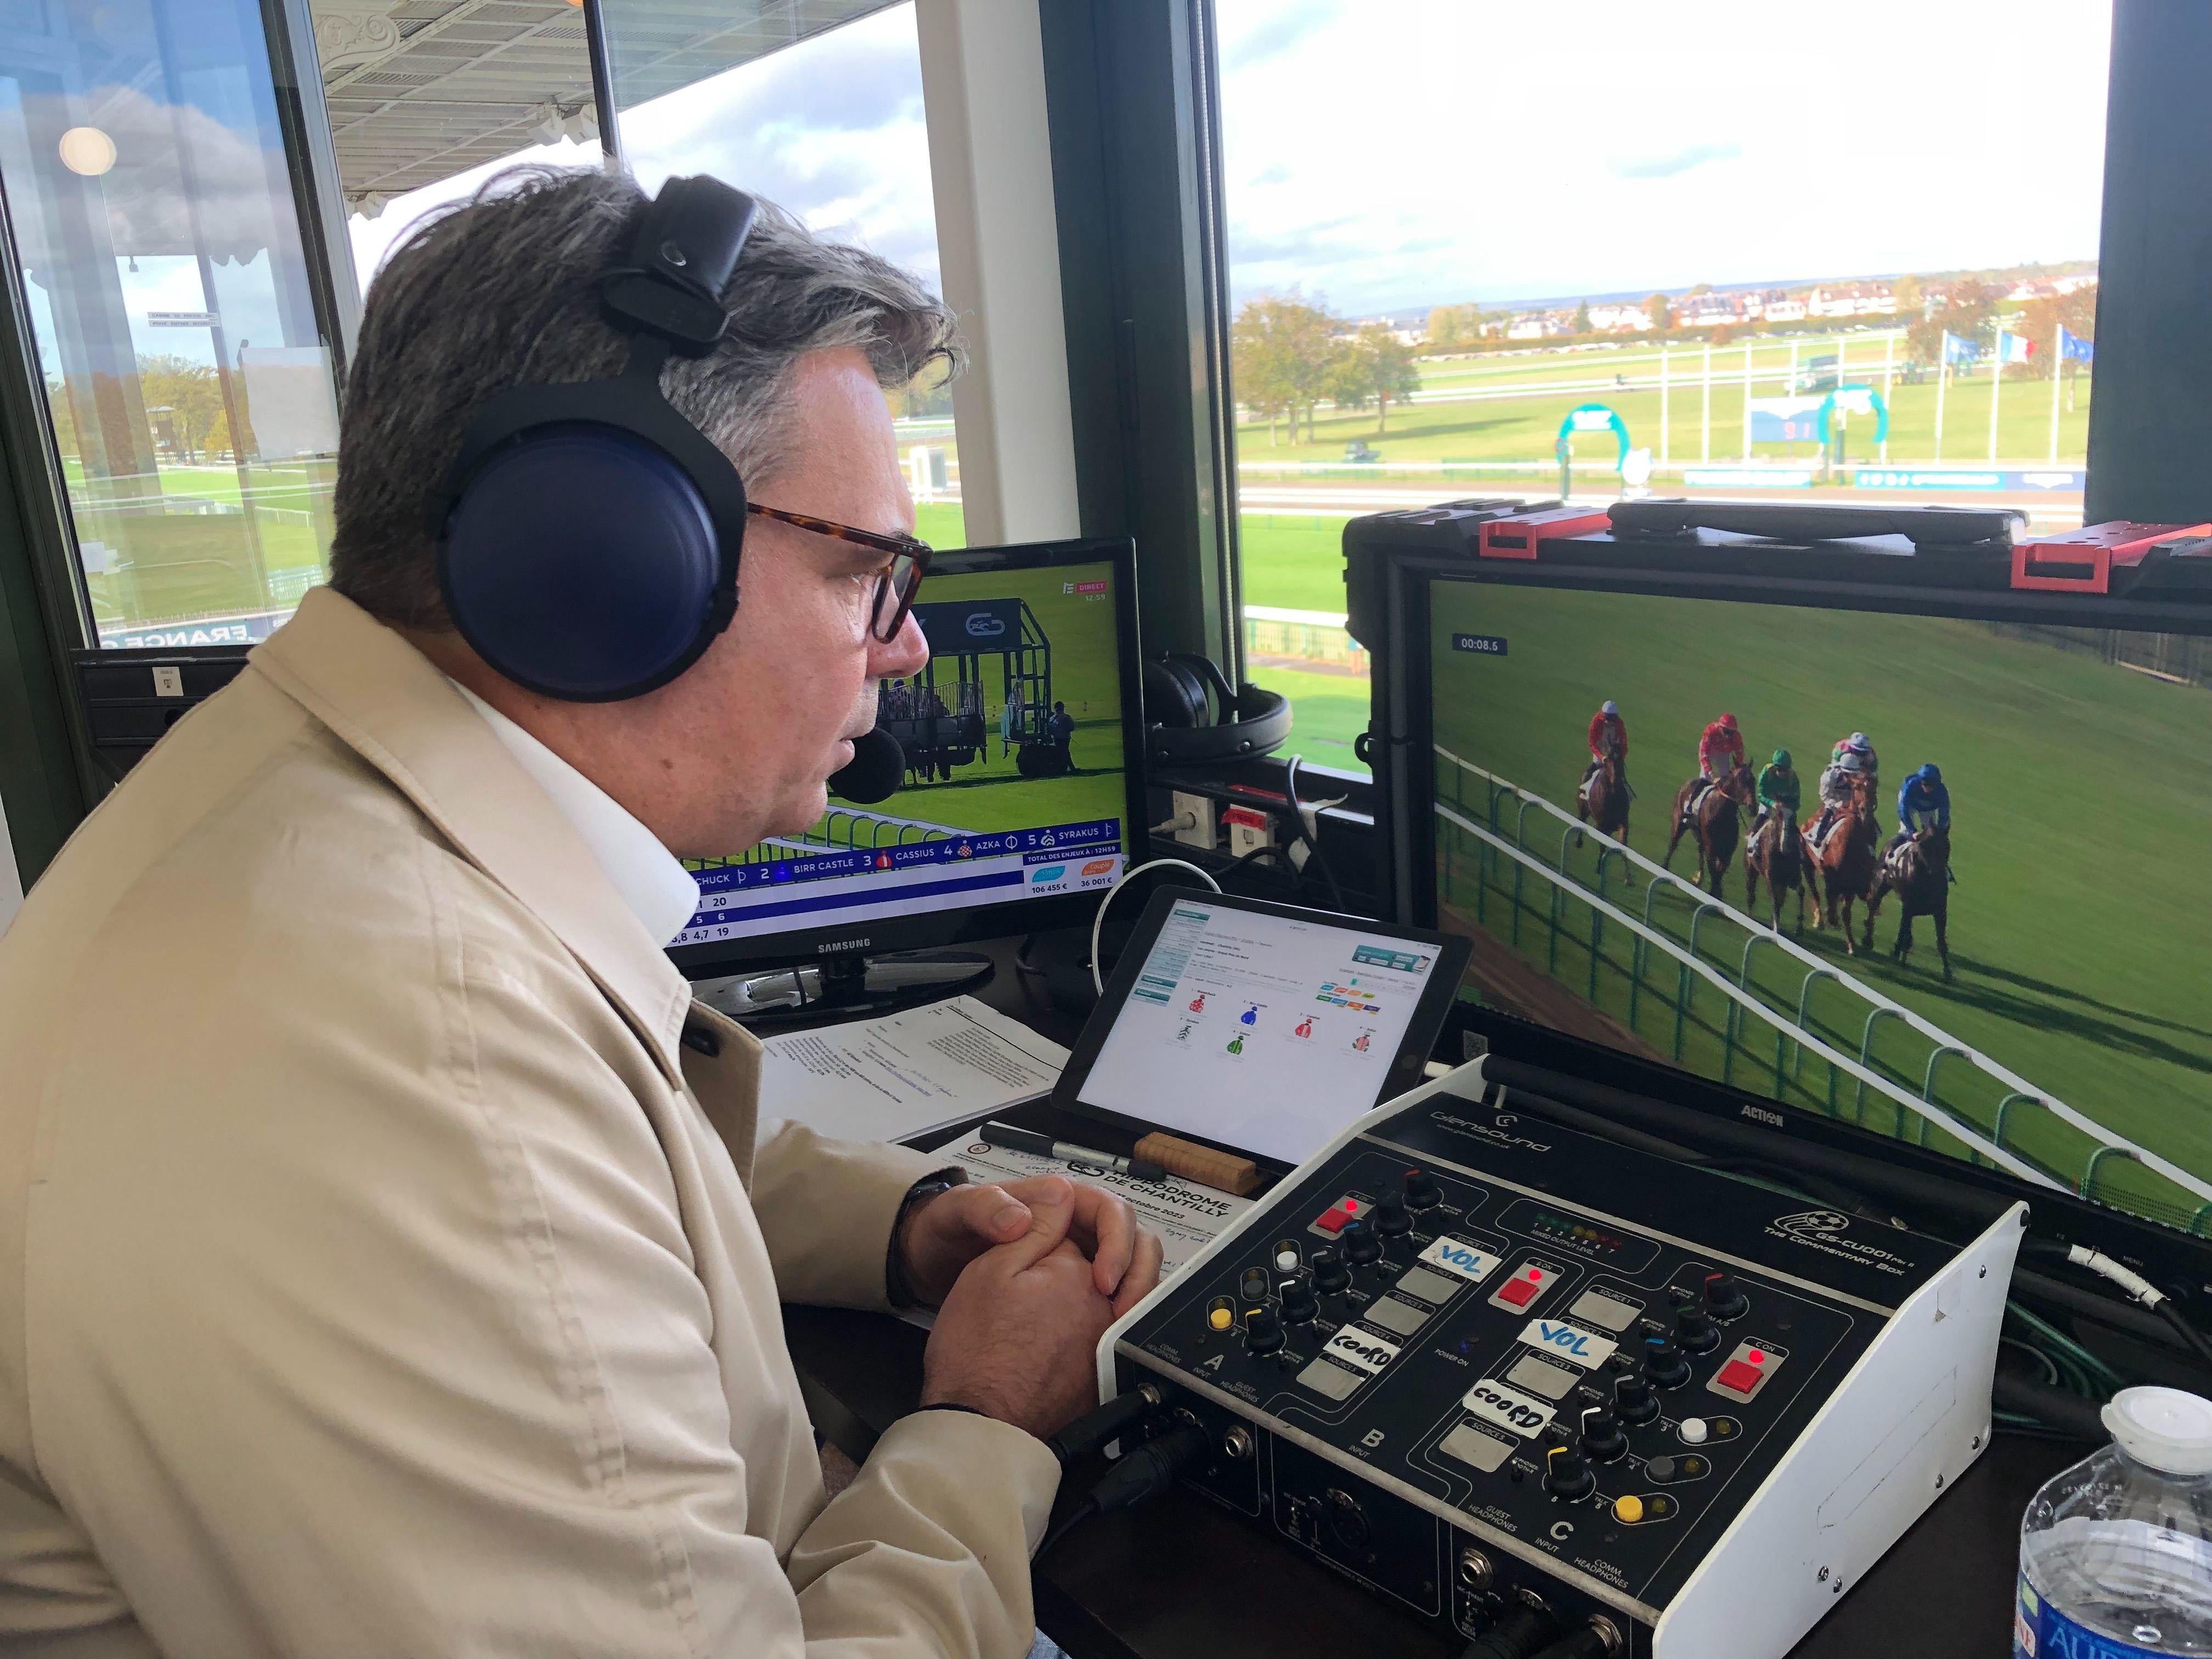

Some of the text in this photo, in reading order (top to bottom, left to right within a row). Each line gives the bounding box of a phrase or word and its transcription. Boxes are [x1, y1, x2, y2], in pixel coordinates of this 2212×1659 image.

[1462, 638, 1498, 651] 00:08.6
[760, 868, 769, 879] 2
[794, 864, 815, 873] BIRR
[818, 859, 854, 870] CASTLE
[864, 856, 871, 866] 3
[896, 849, 934, 860] CASSIUS
[944, 845, 952, 855] 4
[976, 840, 1000, 850] AZKA
[1029, 835, 1036, 845] 5
[1059, 828, 1098, 840] SYRAKUS
[713, 897, 727, 906] 20
[696, 916, 703, 924] 5
[693, 930, 709, 941] 4,7
[717, 927, 729, 936] 19
[818, 938, 871, 953] SAMSUNG
[1741, 1105, 1783, 1127] ACTION
[1430, 1111, 1552, 1152] Glensound
[1103, 1176, 1229, 1218] DE CHANTILLY
[1125, 1197, 1162, 1211] octobre
[1161, 1208, 1186, 1220] 2023
[1457, 1235, 1480, 1248] SOURCE
[1531, 1229, 1594, 1255] MIXED OUTPUT LEVEL
[1815, 1232, 1893, 1260] GS-CU001
[1440, 1245, 1481, 1274] VOL
[1426, 1264, 1449, 1277] SOURCE
[1395, 1294, 1418, 1307] SOURCE
[1599, 1289, 1626, 1301] SOURCE
[1361, 1324, 1385, 1338] SOURCE
[1541, 1322, 1589, 1357] VOL
[1203, 1354, 1225, 1370] A
[1328, 1356, 1352, 1370] SOURCE
[1434, 1348, 1469, 1367] POWER ON
[1538, 1353, 1565, 1368] SOURCE
[1193, 1367, 1211, 1378] INPUT
[1220, 1380, 1260, 1403] HEADPHONES
[1235, 1381, 1256, 1393] GUEST
[1474, 1387, 1544, 1428] COORD
[1471, 1422, 1500, 1437] SOURCE
[1361, 1429, 1385, 1447] B
[1348, 1444, 1370, 1458] INPUT
[1595, 1496, 1609, 1505] TALK
[1469, 1504, 1518, 1532] HEADPHONES
[1486, 1505, 1511, 1520] GUEST
[1550, 1521, 1574, 1541] C
[1535, 1537, 1560, 1553] INPUT
[1574, 1557, 1629, 1588] HEADPHONES
